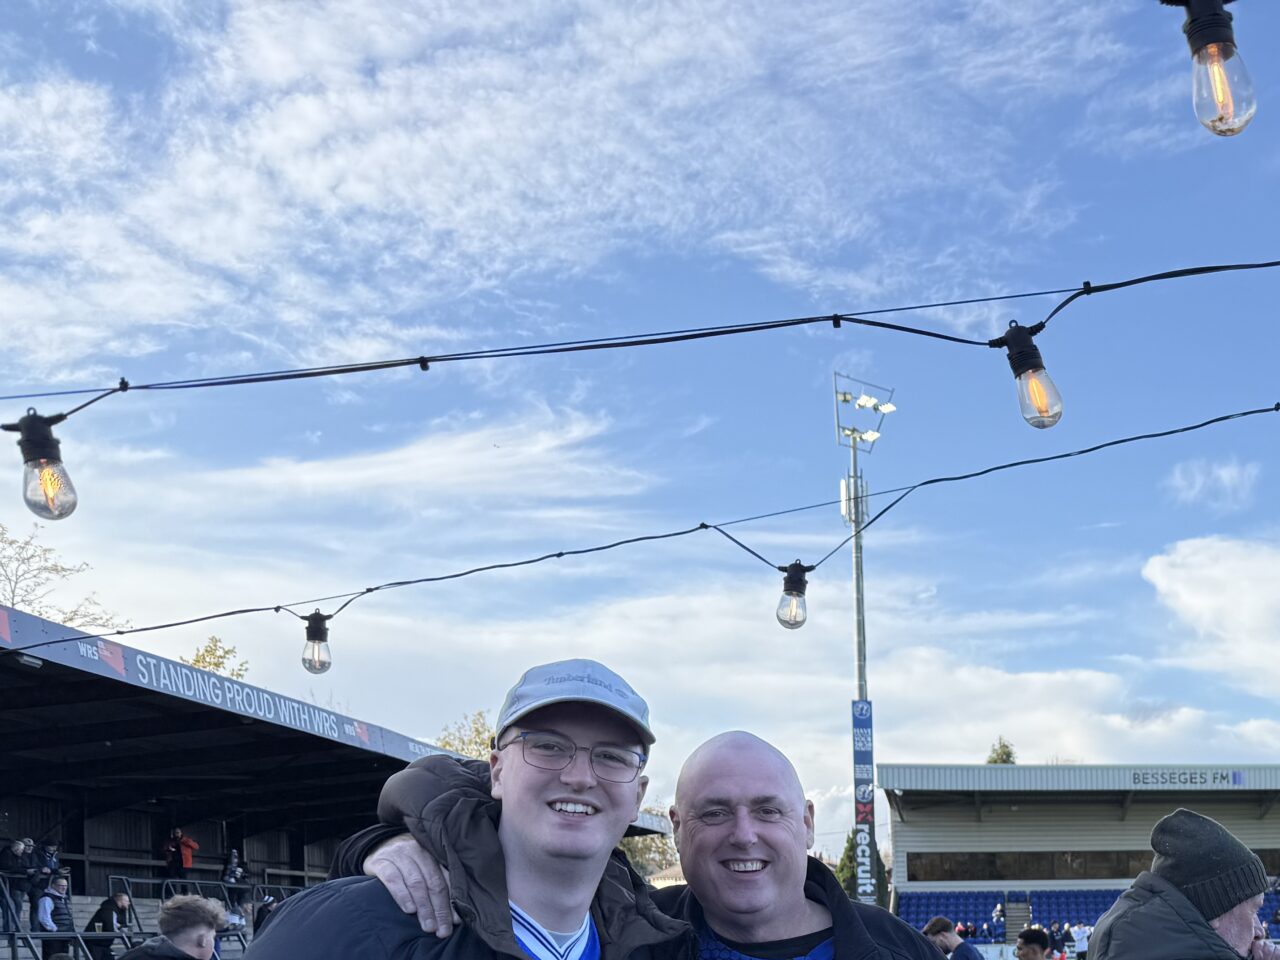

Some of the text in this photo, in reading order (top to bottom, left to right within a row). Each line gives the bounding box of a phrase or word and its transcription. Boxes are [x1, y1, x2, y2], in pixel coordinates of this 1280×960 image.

[78, 641, 99, 660] WRS
[543, 673, 613, 692] Timberland
[136, 654, 338, 738] STANDING PROUD WITH WRS
[1132, 772, 1230, 785] BESSEGES FM
[856, 824, 876, 893] recruit
